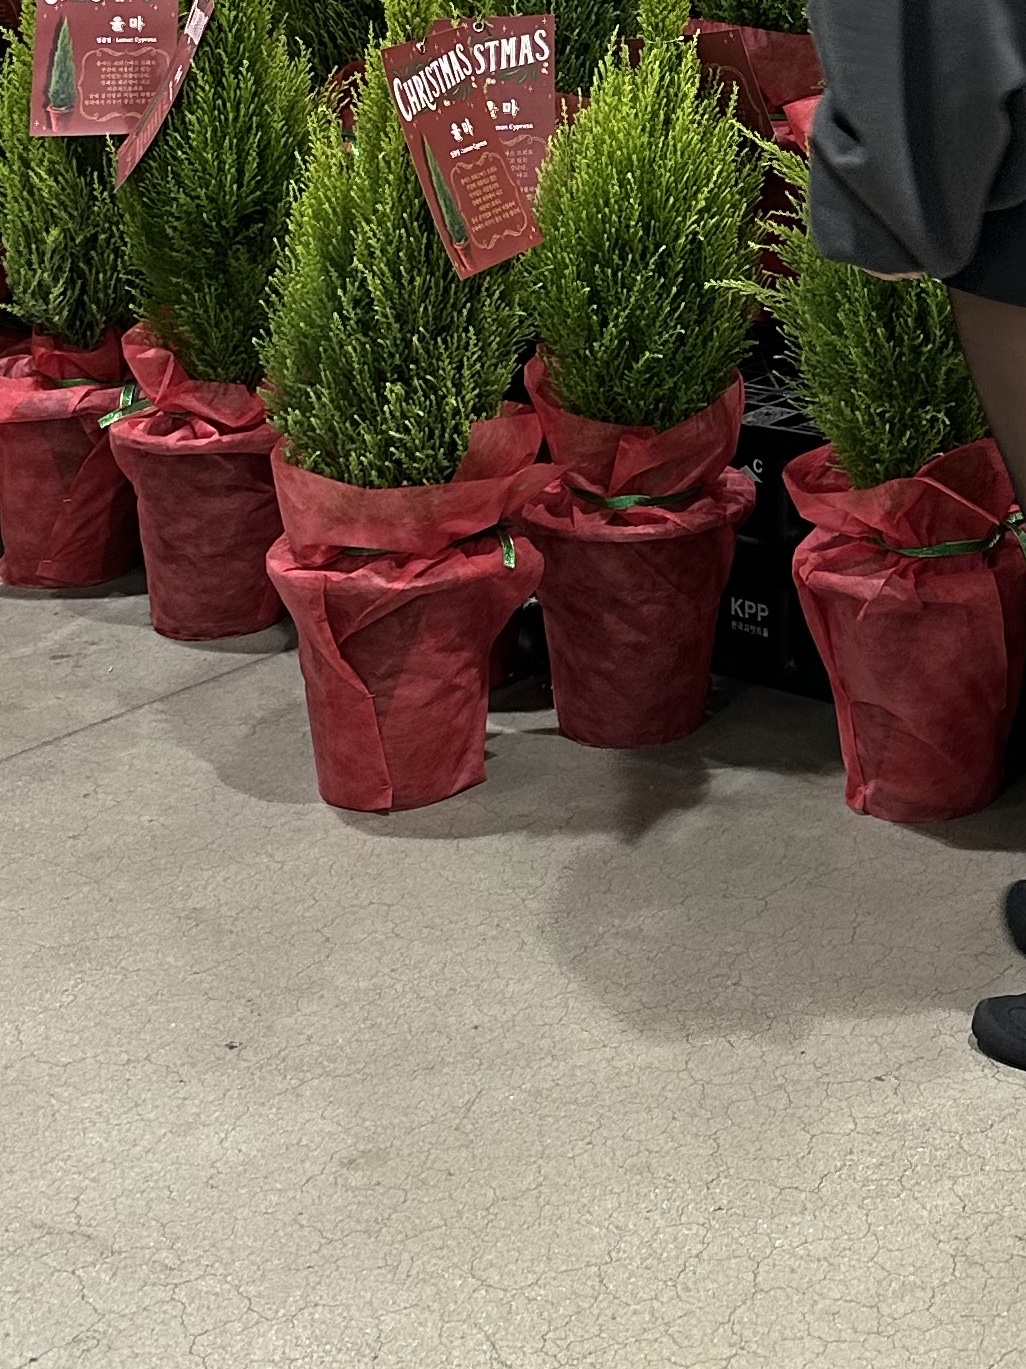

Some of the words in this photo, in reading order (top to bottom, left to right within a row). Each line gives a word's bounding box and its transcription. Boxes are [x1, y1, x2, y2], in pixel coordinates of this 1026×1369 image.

[472, 29, 550, 75] STMAS
[392, 43, 473, 122] CHRISTMAS
[730, 596, 769, 622] KPP
